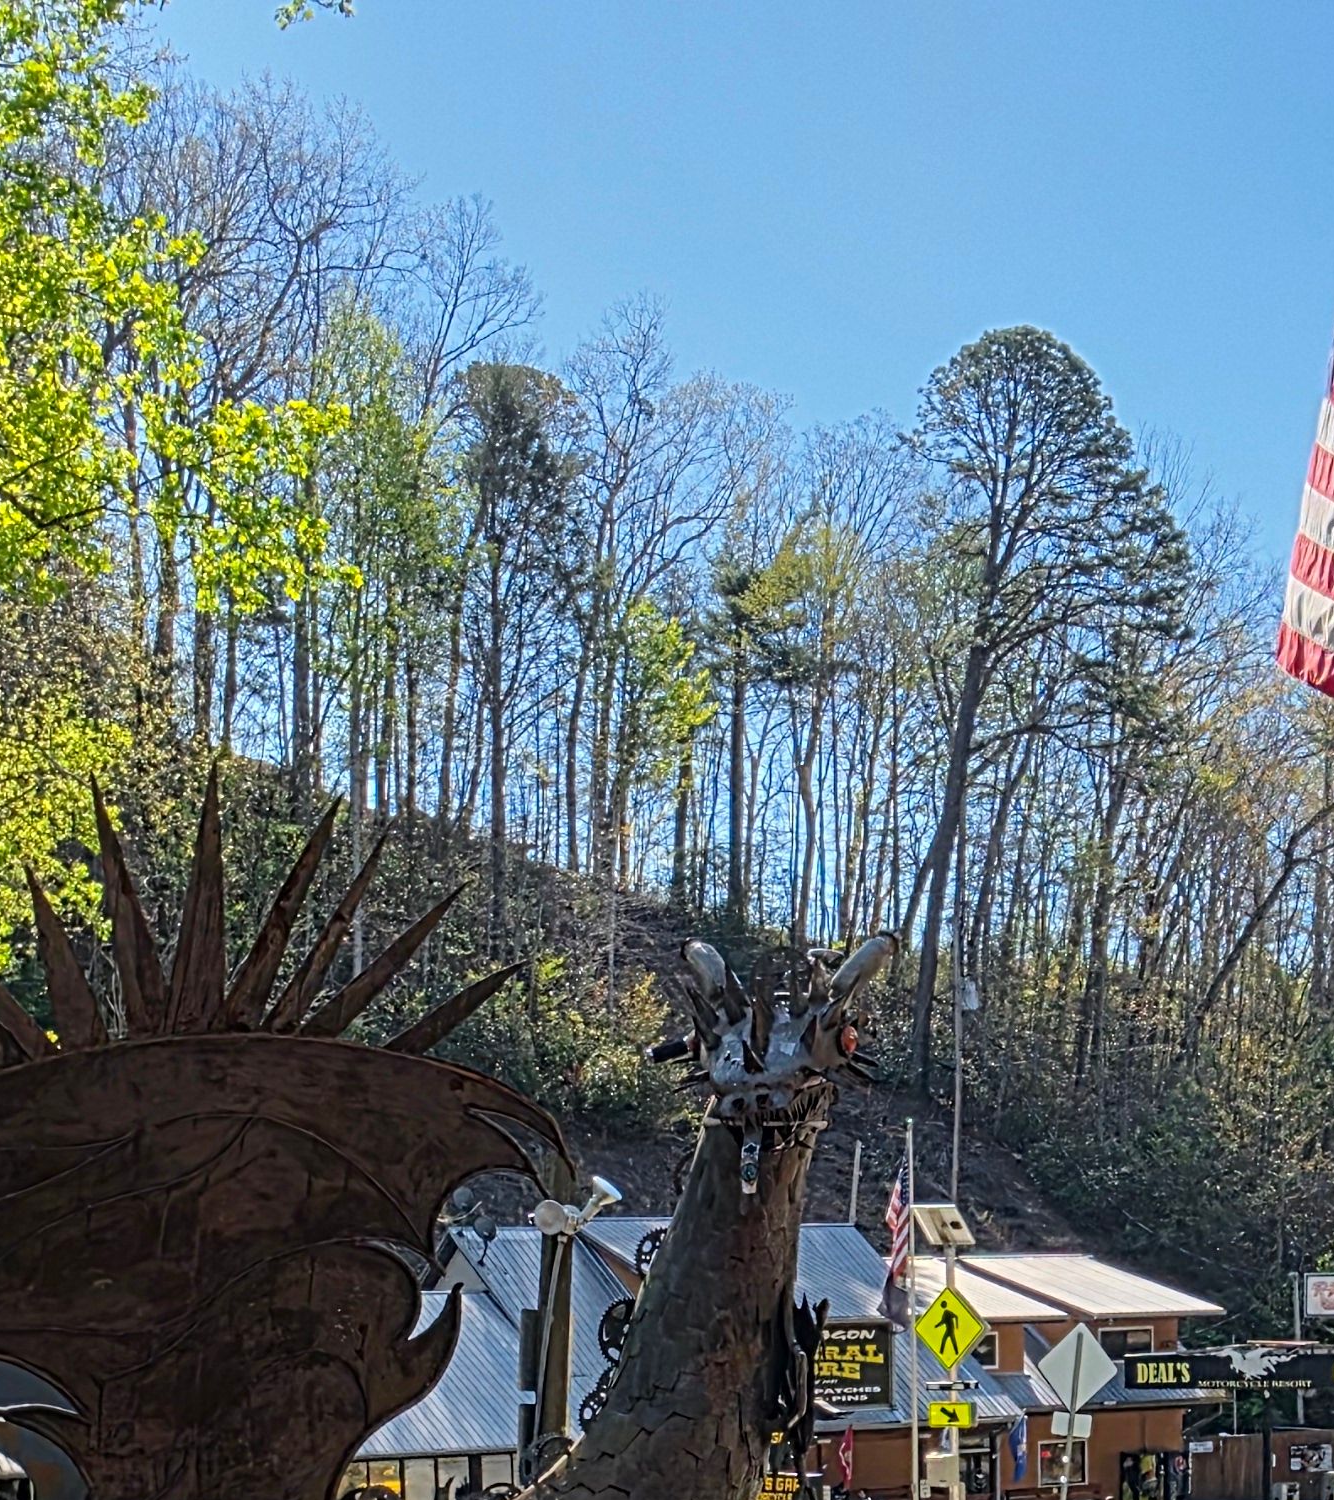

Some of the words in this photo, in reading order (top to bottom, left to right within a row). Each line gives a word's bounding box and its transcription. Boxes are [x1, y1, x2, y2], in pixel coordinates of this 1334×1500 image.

[821, 1344, 884, 1364] RAL
[1136, 1362, 1191, 1384] DEAL'S
[1197, 1380, 1269, 1389] MOTORCYCLE
[1271, 1380, 1313, 1388] RESORT
